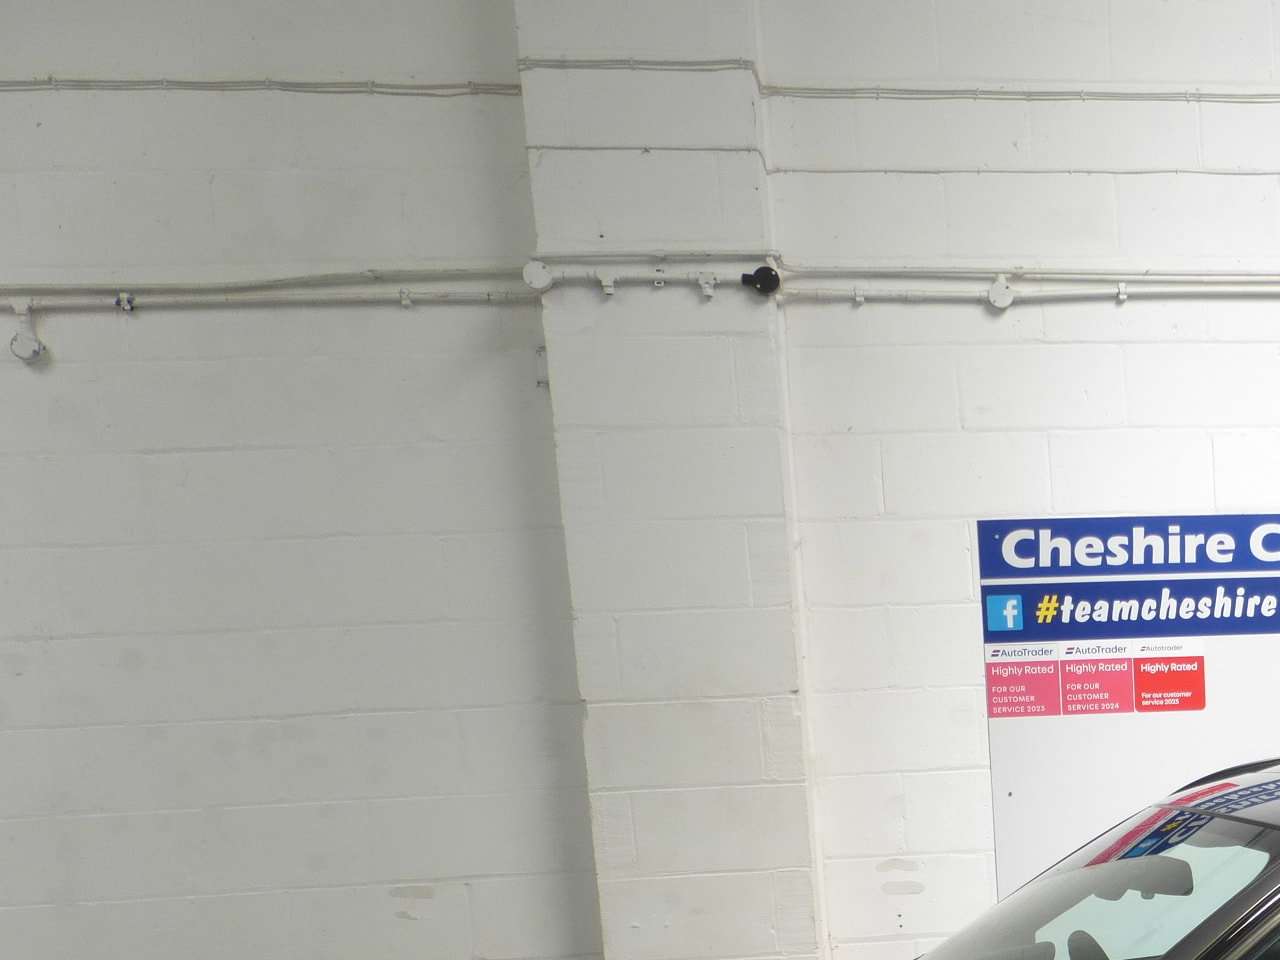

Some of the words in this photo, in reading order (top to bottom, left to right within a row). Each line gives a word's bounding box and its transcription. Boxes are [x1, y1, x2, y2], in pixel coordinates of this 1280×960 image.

[1001, 525, 1236, 569] Cheshire
[1035, 586, 1278, 624] #teamcheshire
[1000, 647, 1053, 657] AutoTrader
[1075, 645, 1127, 655] AutoTrader
[991, 665, 1023, 677] Highly
[1024, 664, 1054, 674] Rated
[1065, 663, 1097, 675] Highly
[1098, 662, 1128, 672] Rated
[1140, 662, 1170, 674] Highly
[1170, 661, 1198, 672] Rated
[1009, 685, 1026, 693] OUR
[1066, 683, 1082, 691] FOR
[992, 695, 1035, 704] CUSTOMER
[1067, 692, 1109, 701] CUSTOMER
[992, 706, 1026, 714] SERVICE
[1067, 703, 1100, 711] SERVICE
